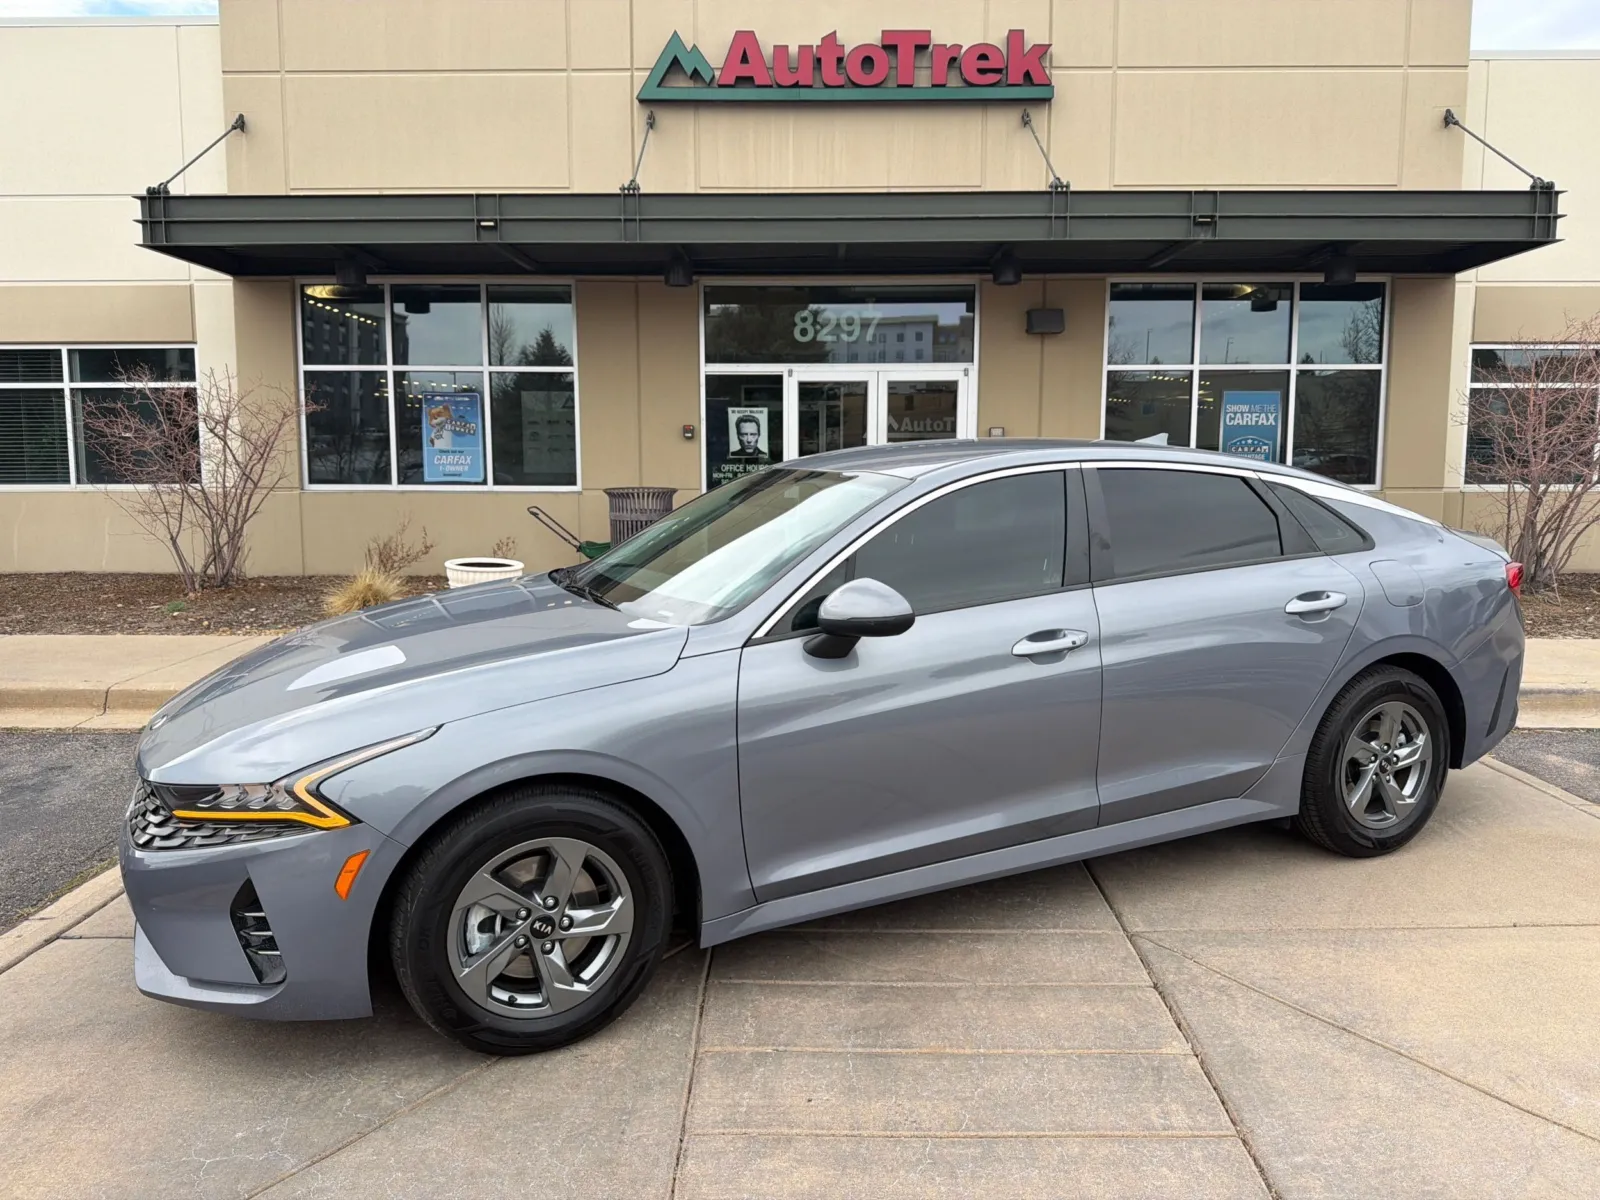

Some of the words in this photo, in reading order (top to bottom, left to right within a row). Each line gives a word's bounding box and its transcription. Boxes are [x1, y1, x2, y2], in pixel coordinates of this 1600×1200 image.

[717, 29, 1052, 87] AutoTrek
[793, 310, 882, 342] 8297
[1226, 404, 1249, 412] SHOW
[1250, 404, 1261, 412] ME
[1262, 404, 1276, 412] THE
[901, 417, 955, 431] AutoT
[1226, 413, 1276, 426] CARFAX
[434, 455, 472, 464] CARFAX
[721, 464, 744, 472] OFFICE
[533, 920, 552, 934] KIA
